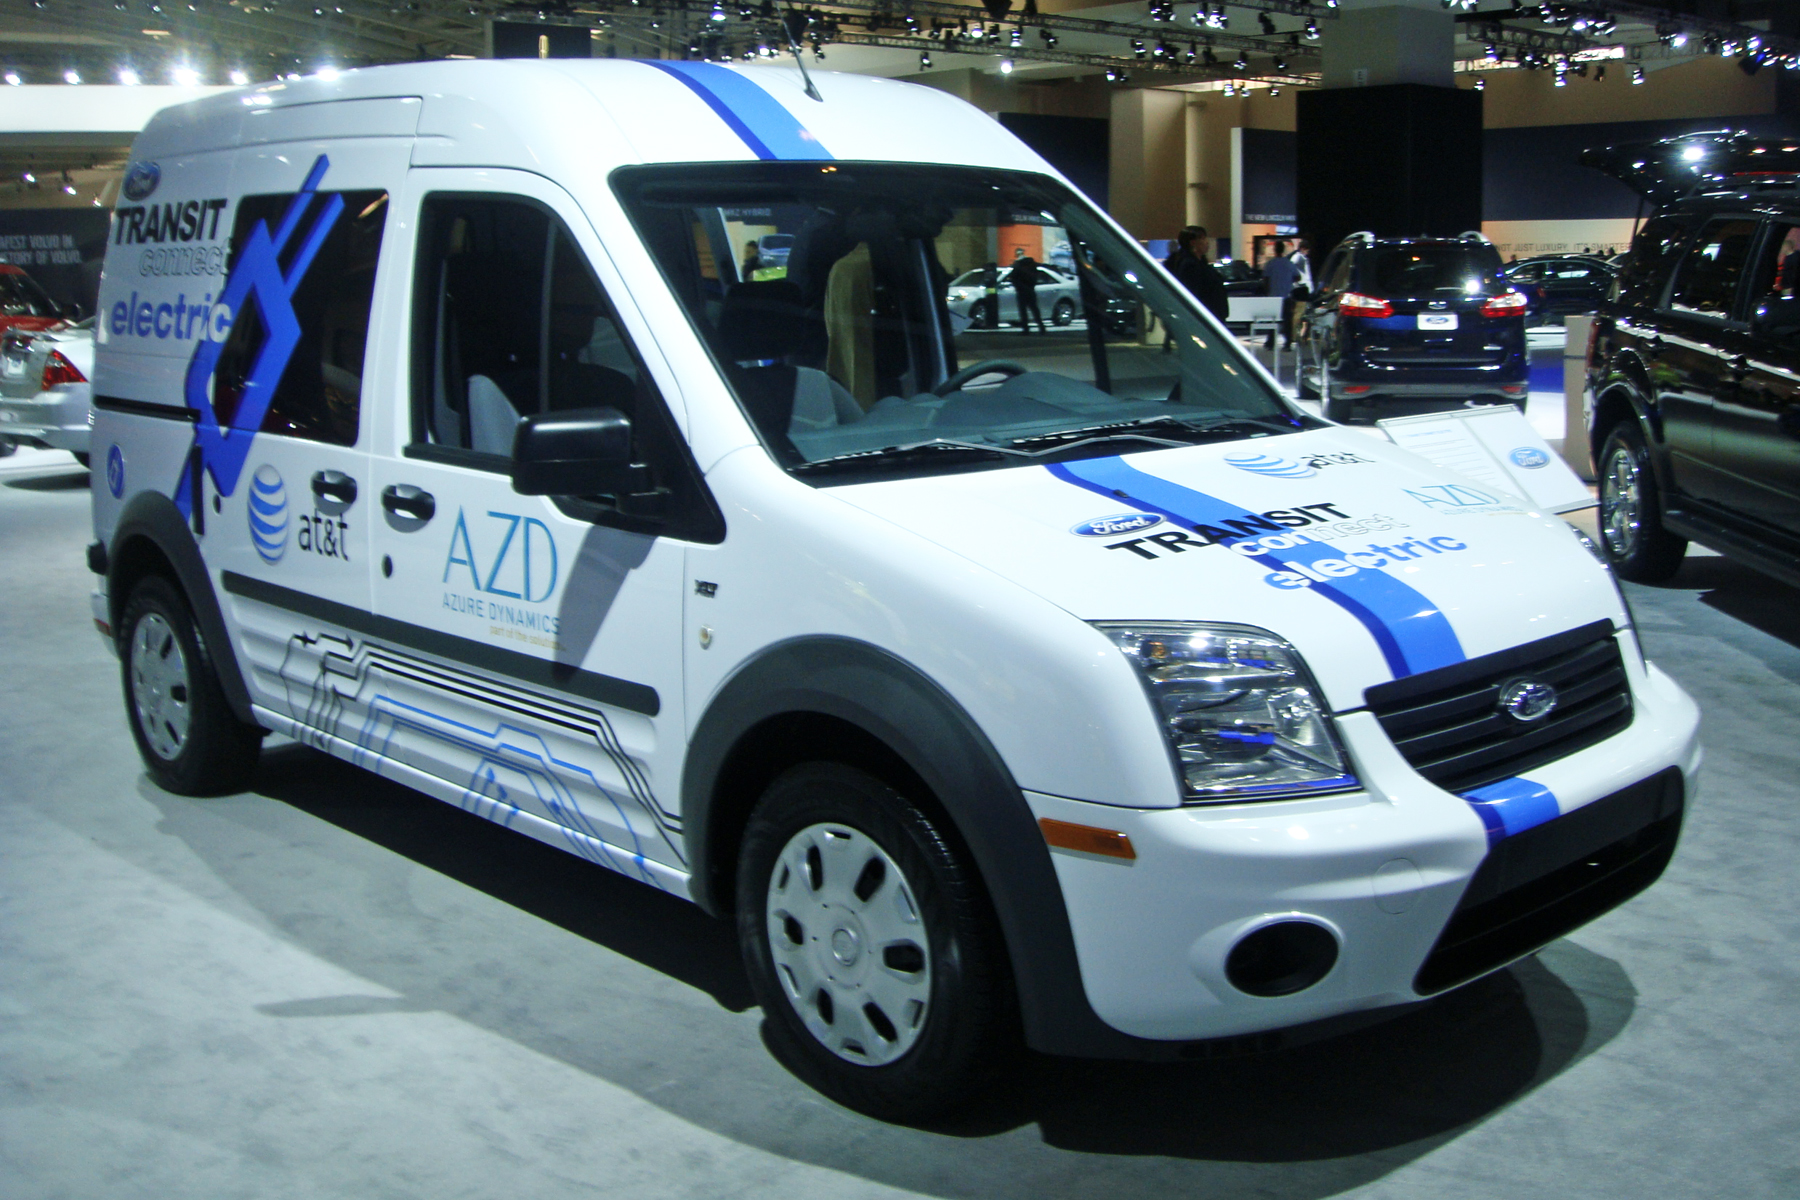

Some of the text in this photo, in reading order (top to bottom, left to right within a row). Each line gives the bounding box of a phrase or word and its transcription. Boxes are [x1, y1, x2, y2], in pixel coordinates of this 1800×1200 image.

[115, 198, 228, 244] TRANSIT
[140, 236, 232, 277] connect
[1514, 243, 1534, 252] JUST
[111, 291, 233, 343] electric
[1300, 452, 1377, 470] at&t
[1401, 483, 1500, 509] AZD
[298, 507, 349, 562] at&t
[442, 503, 557, 603] AZD
[1102, 502, 1352, 560] TRANSIT
[1230, 513, 1410, 557] connect
[1263, 536, 1468, 590] electric
[442, 592, 562, 635] AZURE DYNAMICS
